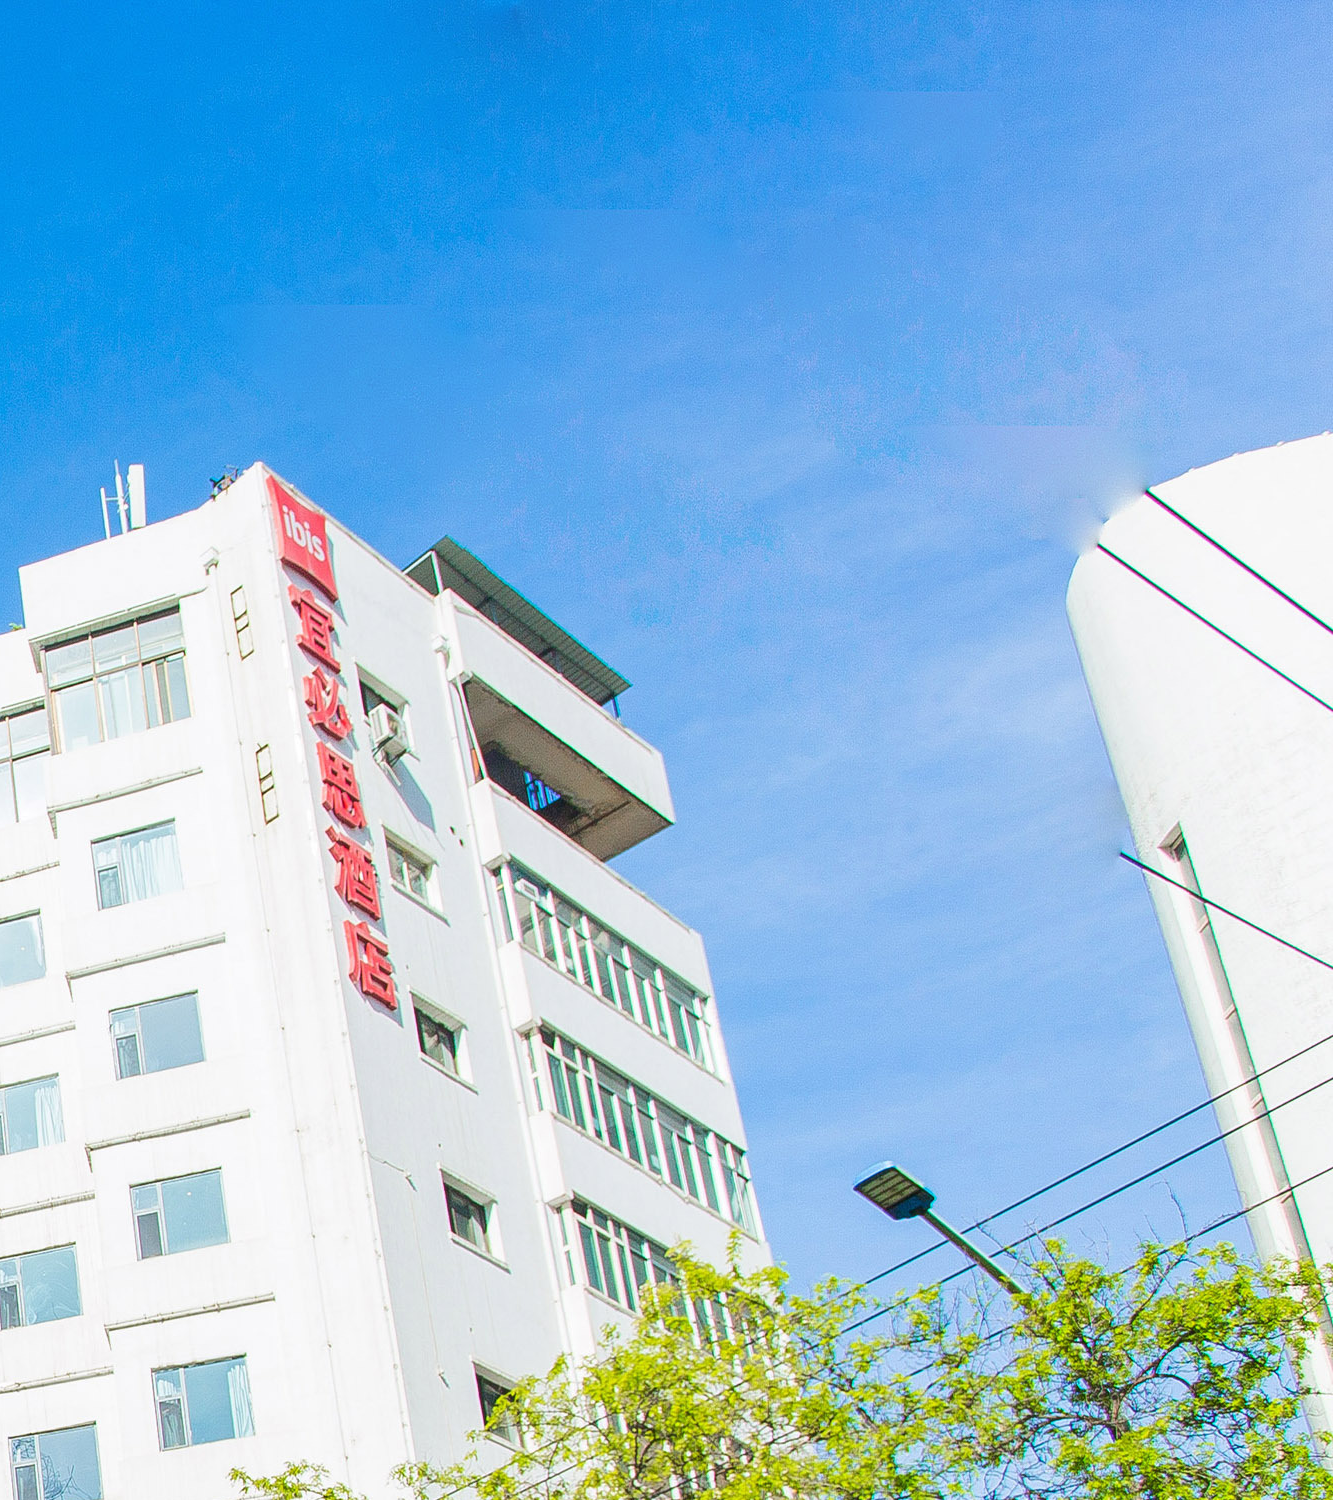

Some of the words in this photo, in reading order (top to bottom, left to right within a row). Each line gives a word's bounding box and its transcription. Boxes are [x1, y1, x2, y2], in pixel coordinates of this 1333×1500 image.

[281, 504, 325, 563] ibis
[288, 583, 398, 1012] 宜必思酒店
